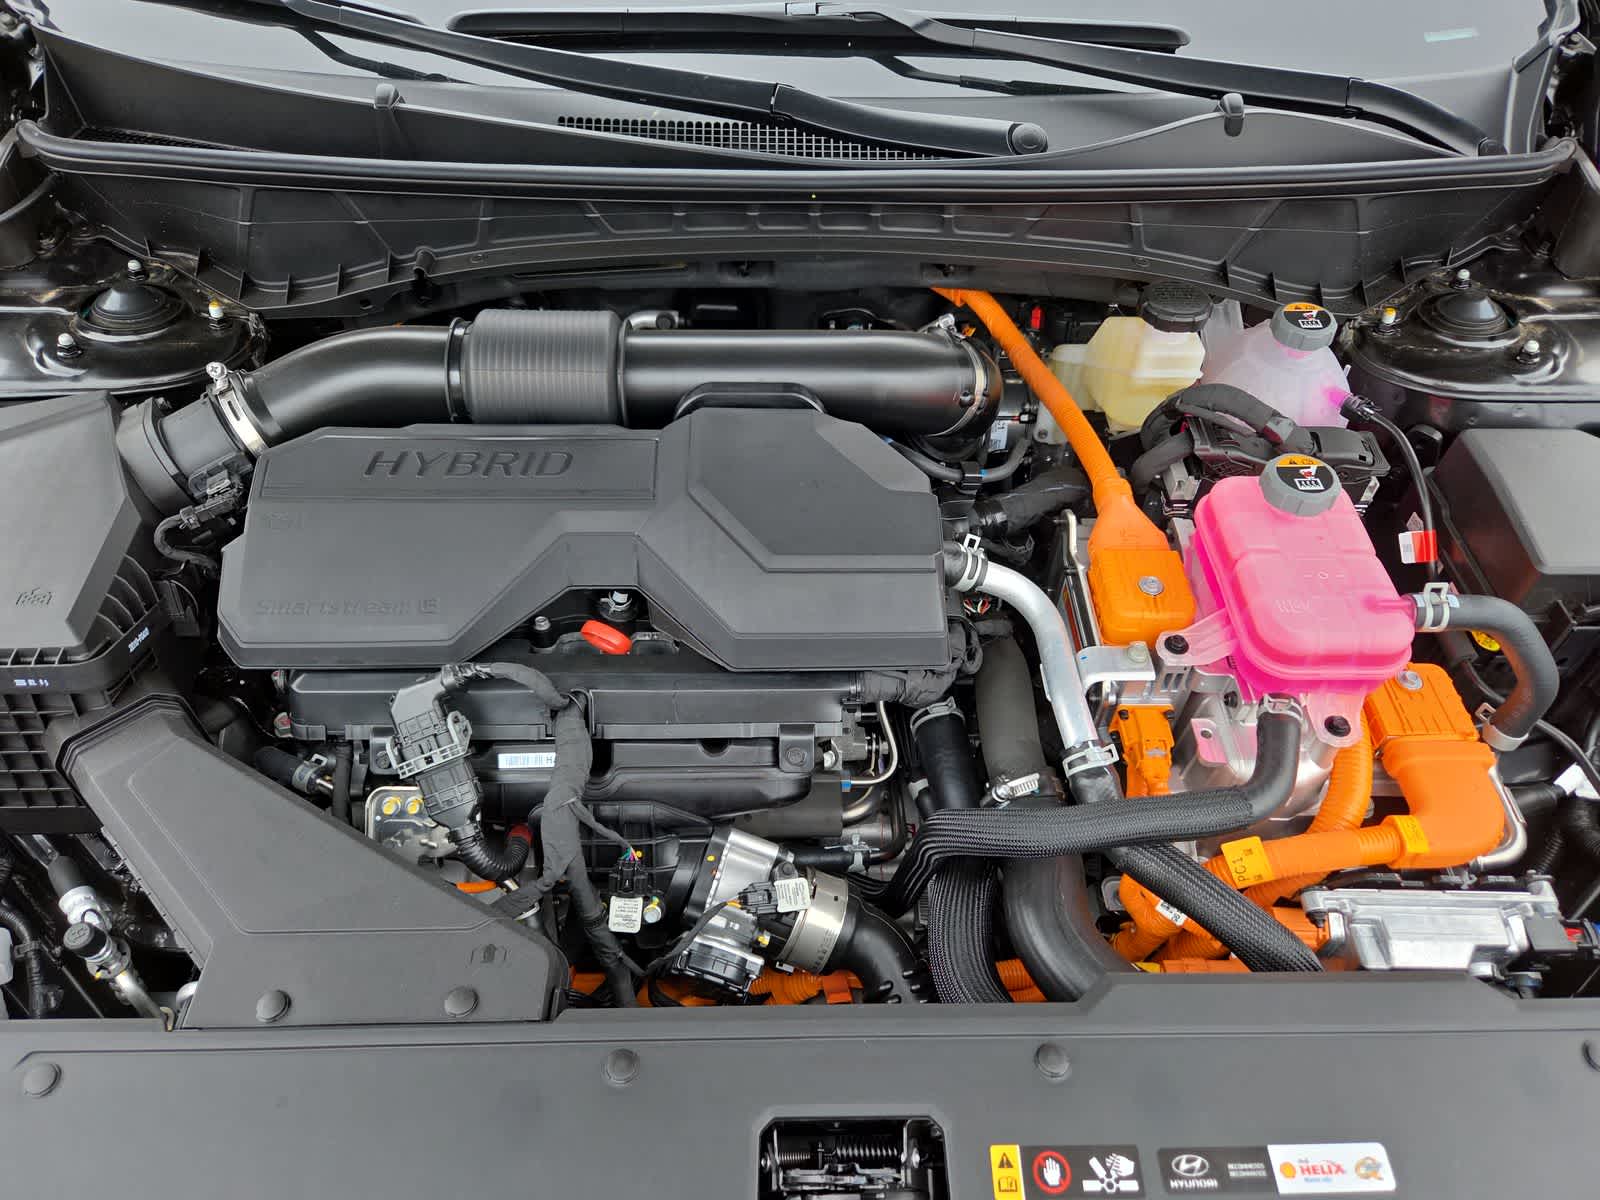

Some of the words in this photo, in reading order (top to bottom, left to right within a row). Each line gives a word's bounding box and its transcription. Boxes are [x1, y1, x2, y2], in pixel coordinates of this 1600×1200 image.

[363, 450, 574, 478] HYBRID
[256, 598, 410, 615] Smartstream
[1231, 856, 1250, 882] PC1
[1299, 1163, 1345, 1176] HELIX
[1169, 1178, 1219, 1189] HYUNDAI
